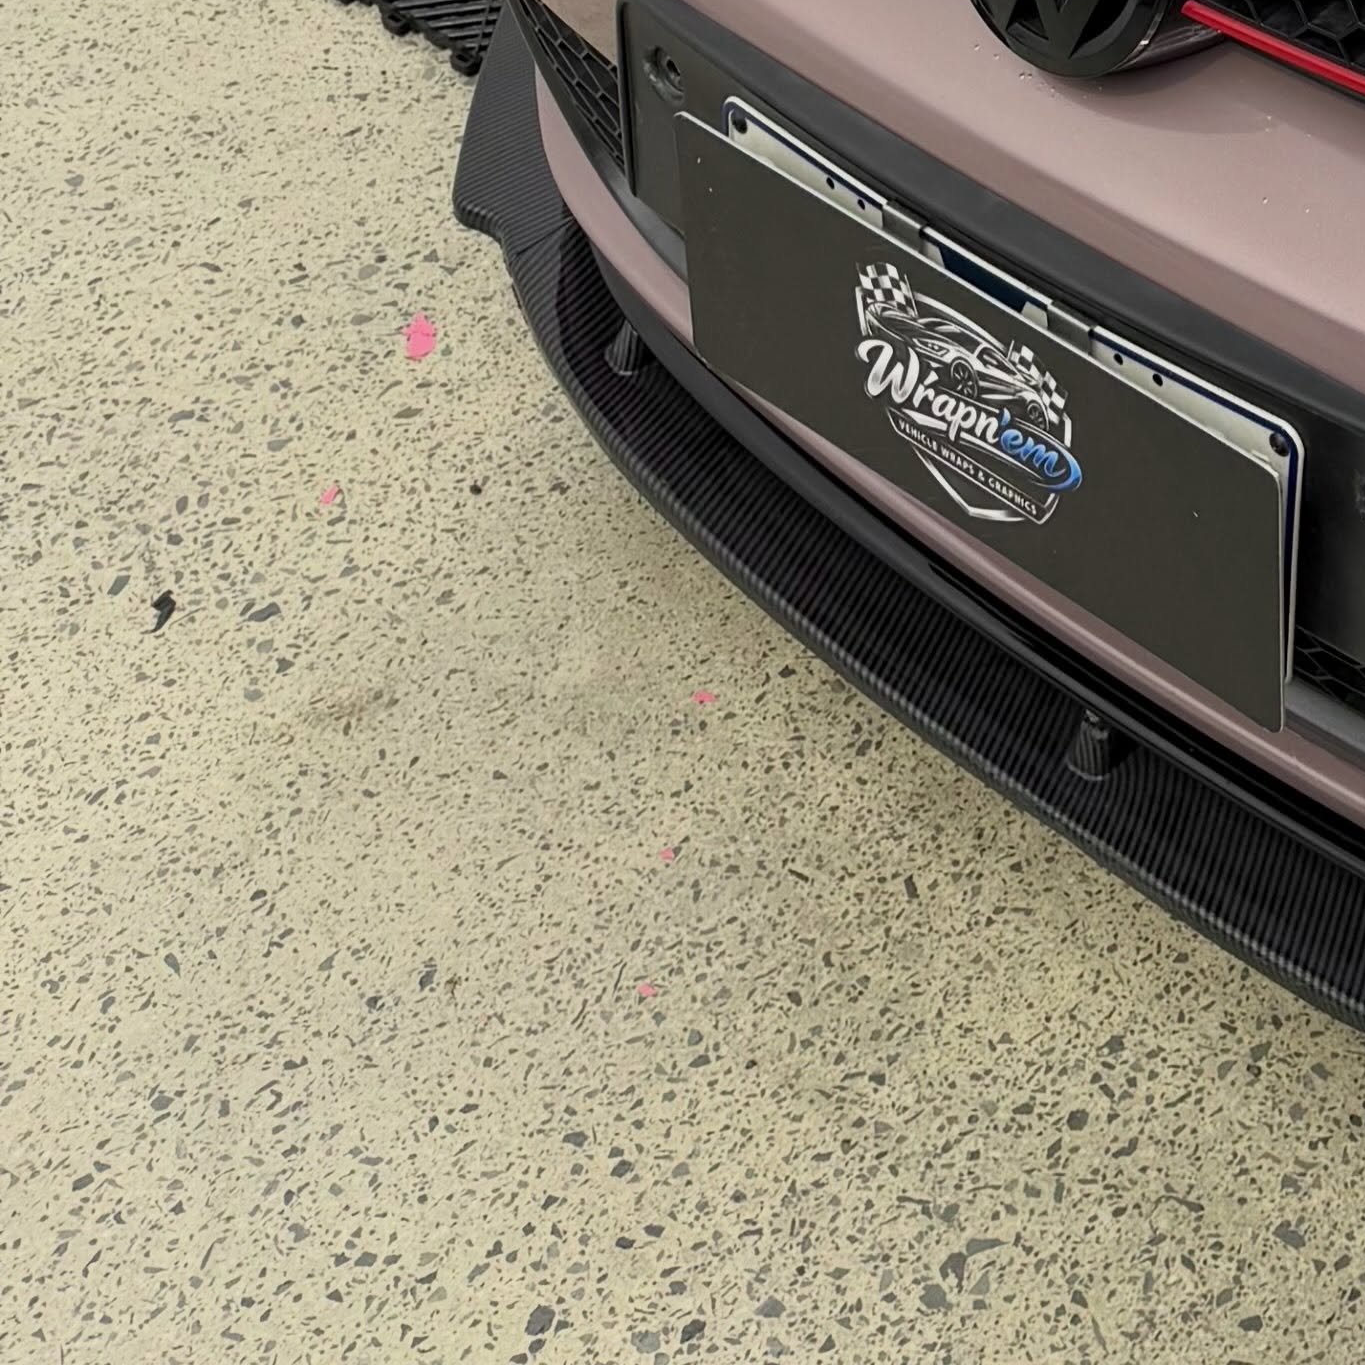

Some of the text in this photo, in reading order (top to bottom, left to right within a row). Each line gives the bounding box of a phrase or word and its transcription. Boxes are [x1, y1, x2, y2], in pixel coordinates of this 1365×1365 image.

[899, 419, 937, 452] VEHICLE
[941, 445, 974, 475] WRAPS
[988, 477, 1037, 515] GRAPHICS
